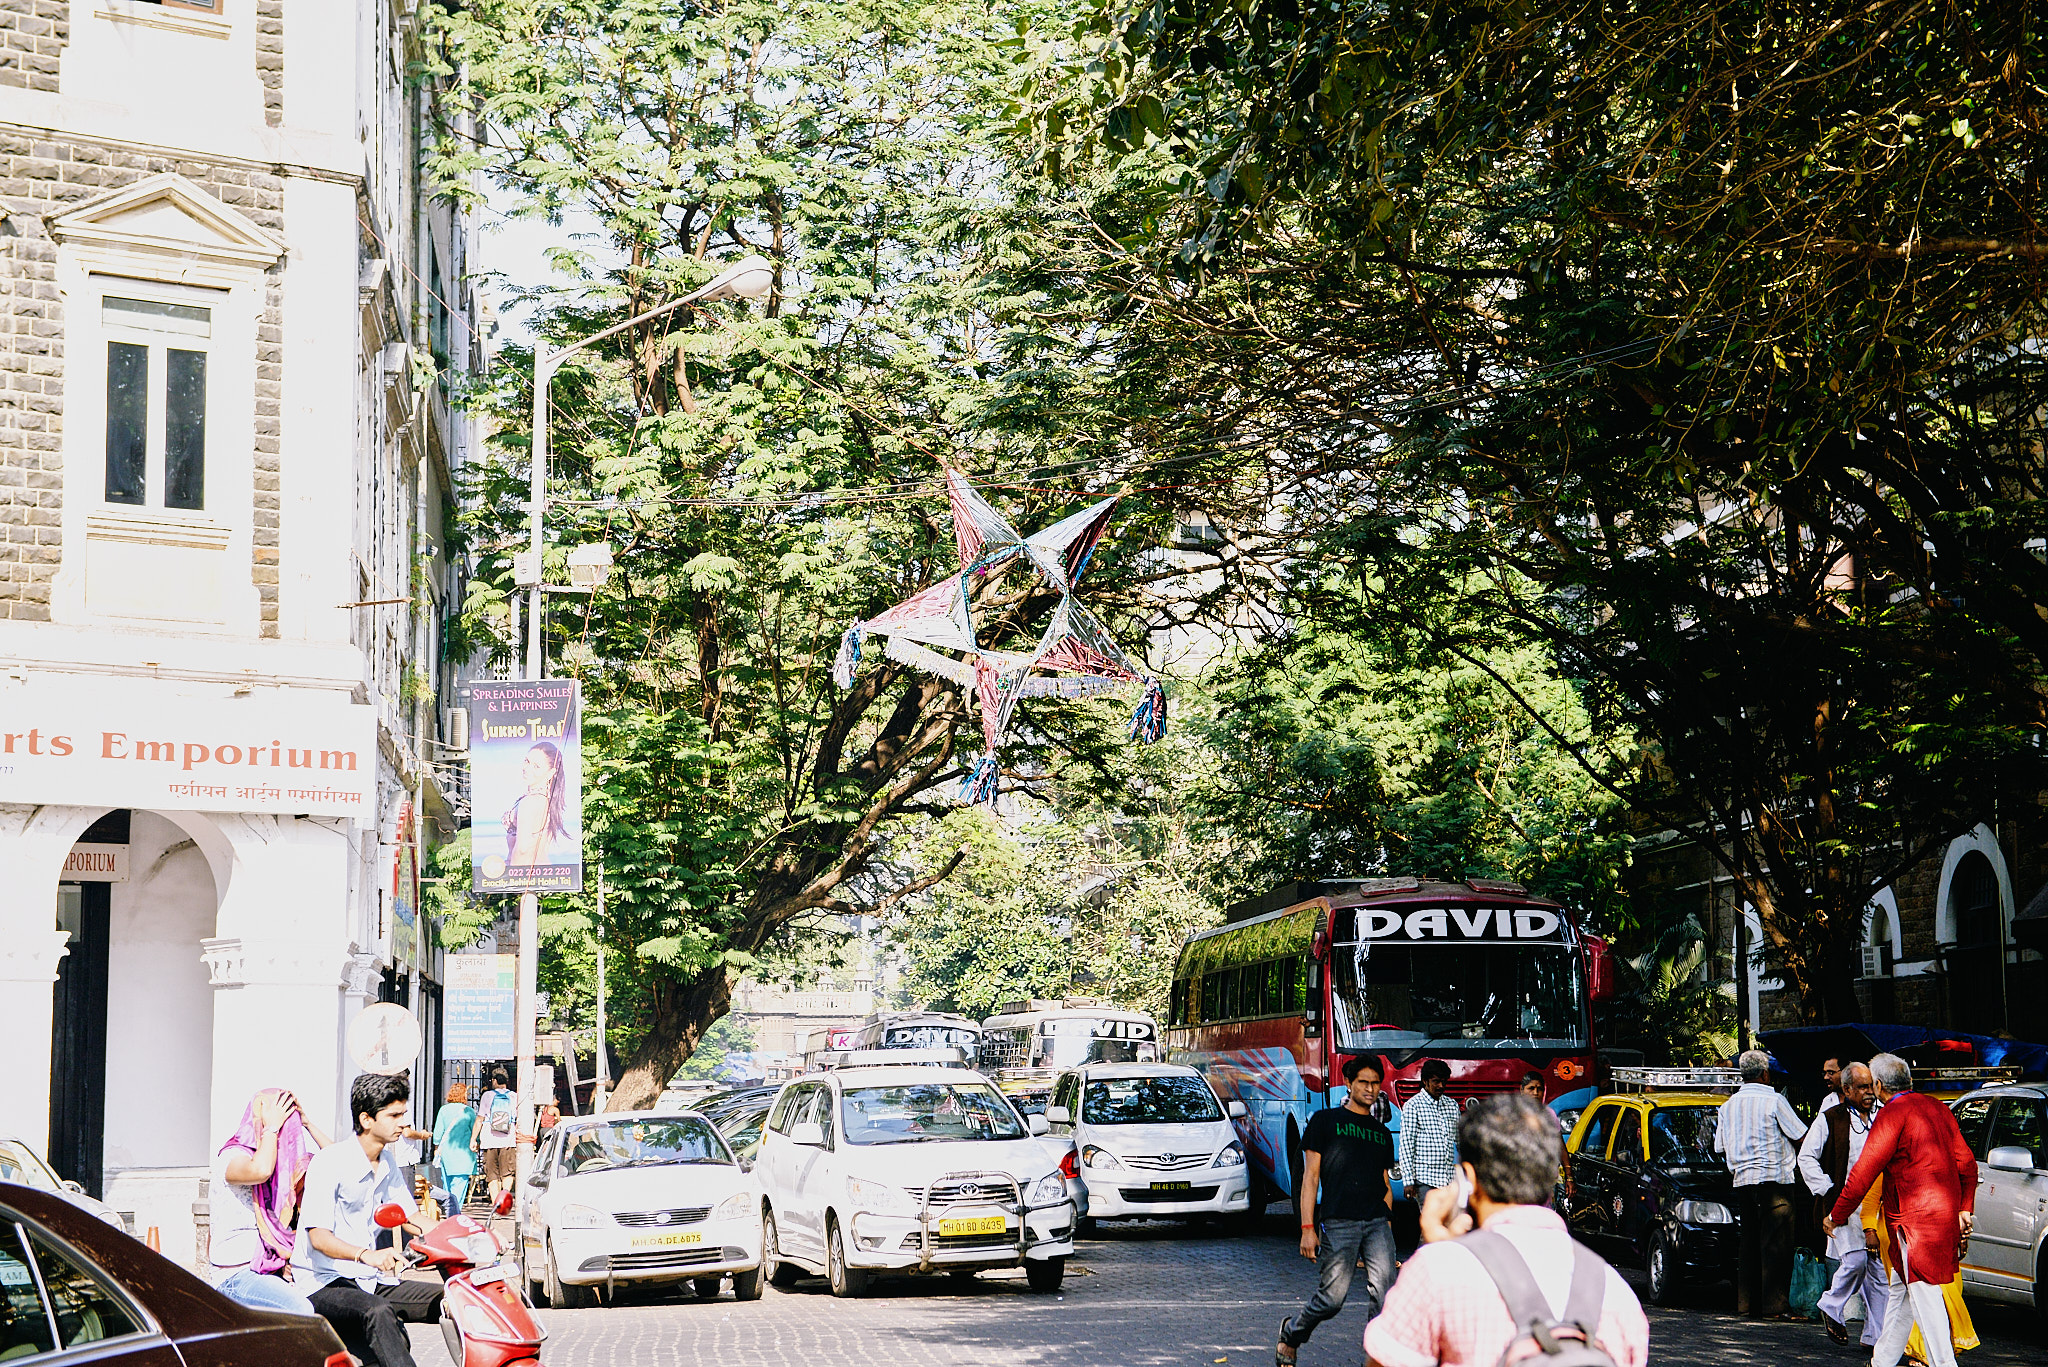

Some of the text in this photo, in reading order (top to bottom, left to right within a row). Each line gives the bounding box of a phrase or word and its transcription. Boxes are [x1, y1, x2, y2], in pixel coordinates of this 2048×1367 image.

[473, 687, 571, 700] SPREADING SMILES
[488, 700, 558, 712] & HAPPINESS
[481, 718, 527, 742] SUKHO
[100, 731, 358, 771] Emporium
[508, 867, 571, 877] 022 220 22 220
[481, 878, 509, 888] Exactly
[537, 876, 559, 886] Hotel
[560, 876, 571, 886] Taj
[1354, 908, 1560, 940] DAVID
[895, 1030, 976, 1044] DAVID
[1562, 1065, 1572, 1075] 3
[1336, 1122, 1386, 1145] WANTED
[943, 1223, 954, 1232] MH
